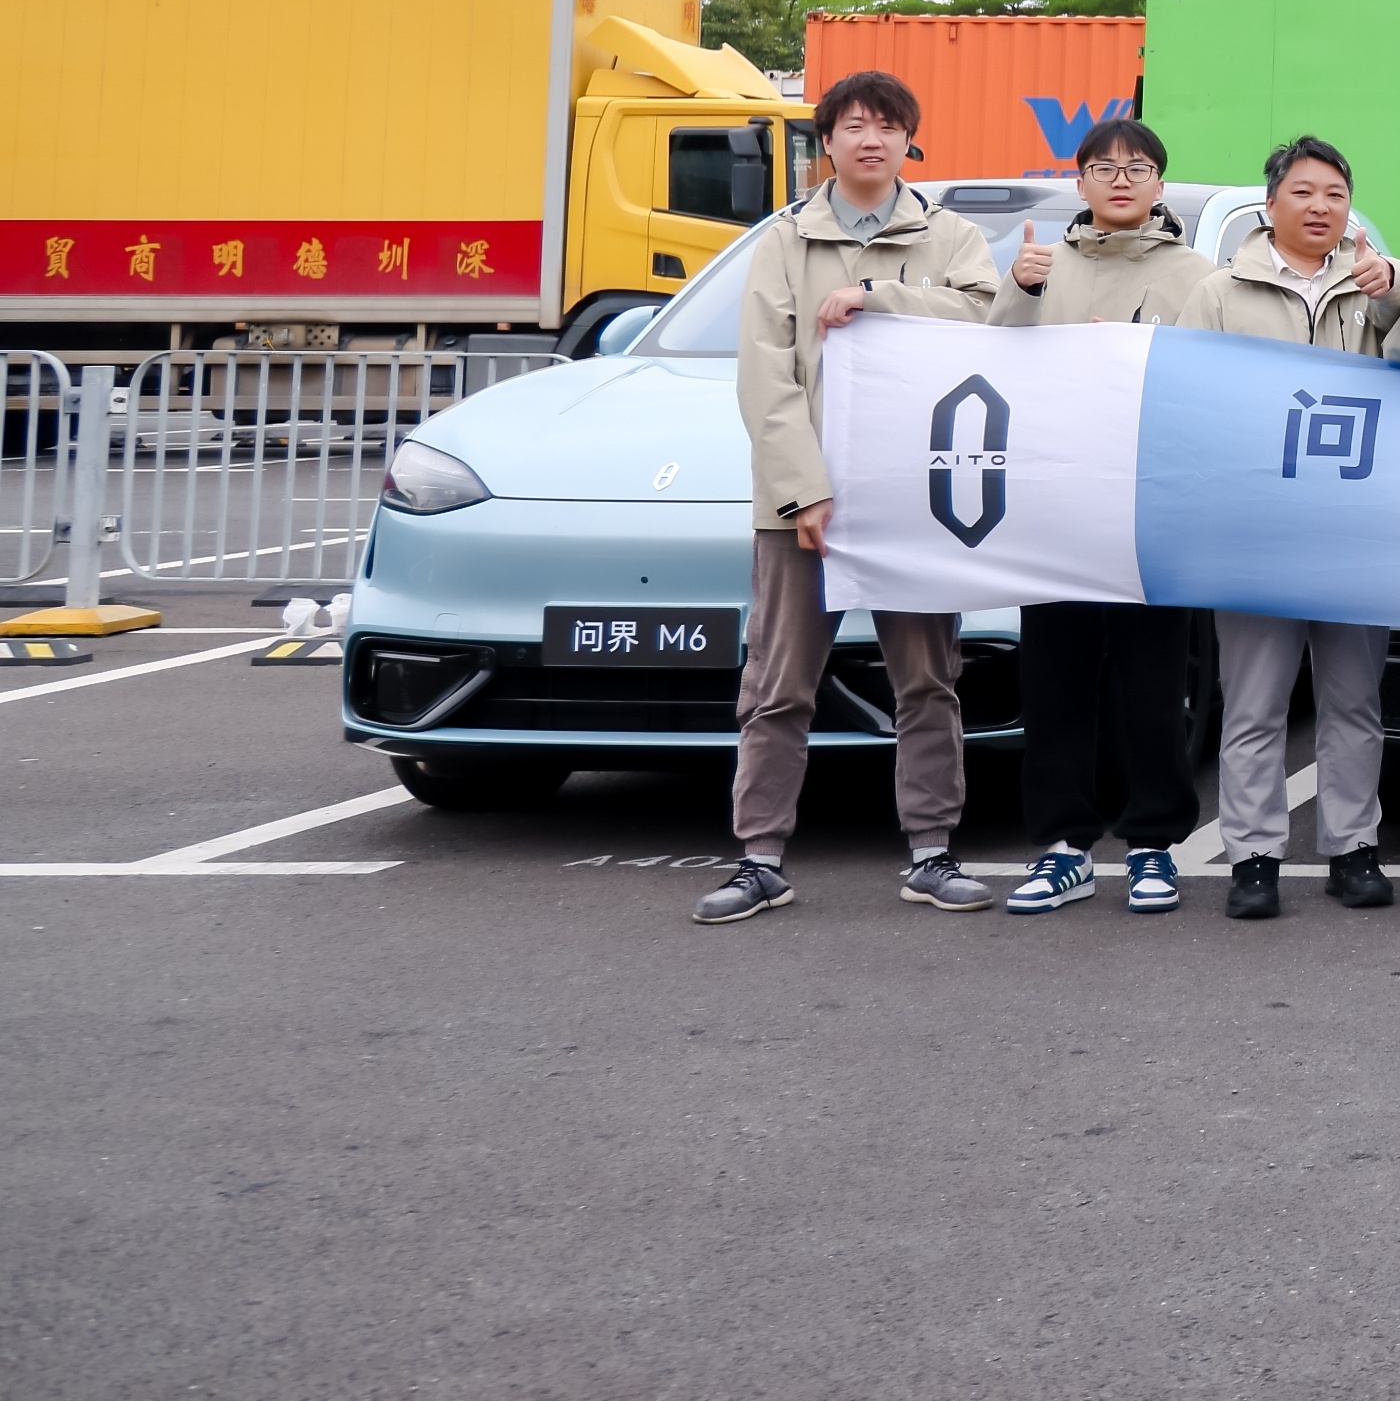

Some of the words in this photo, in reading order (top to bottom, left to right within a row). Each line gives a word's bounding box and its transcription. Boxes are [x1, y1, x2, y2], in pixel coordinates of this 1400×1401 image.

[929, 454, 1006, 466] AITO
[574, 619, 639, 653] 问界
[658, 623, 707, 652] M6
